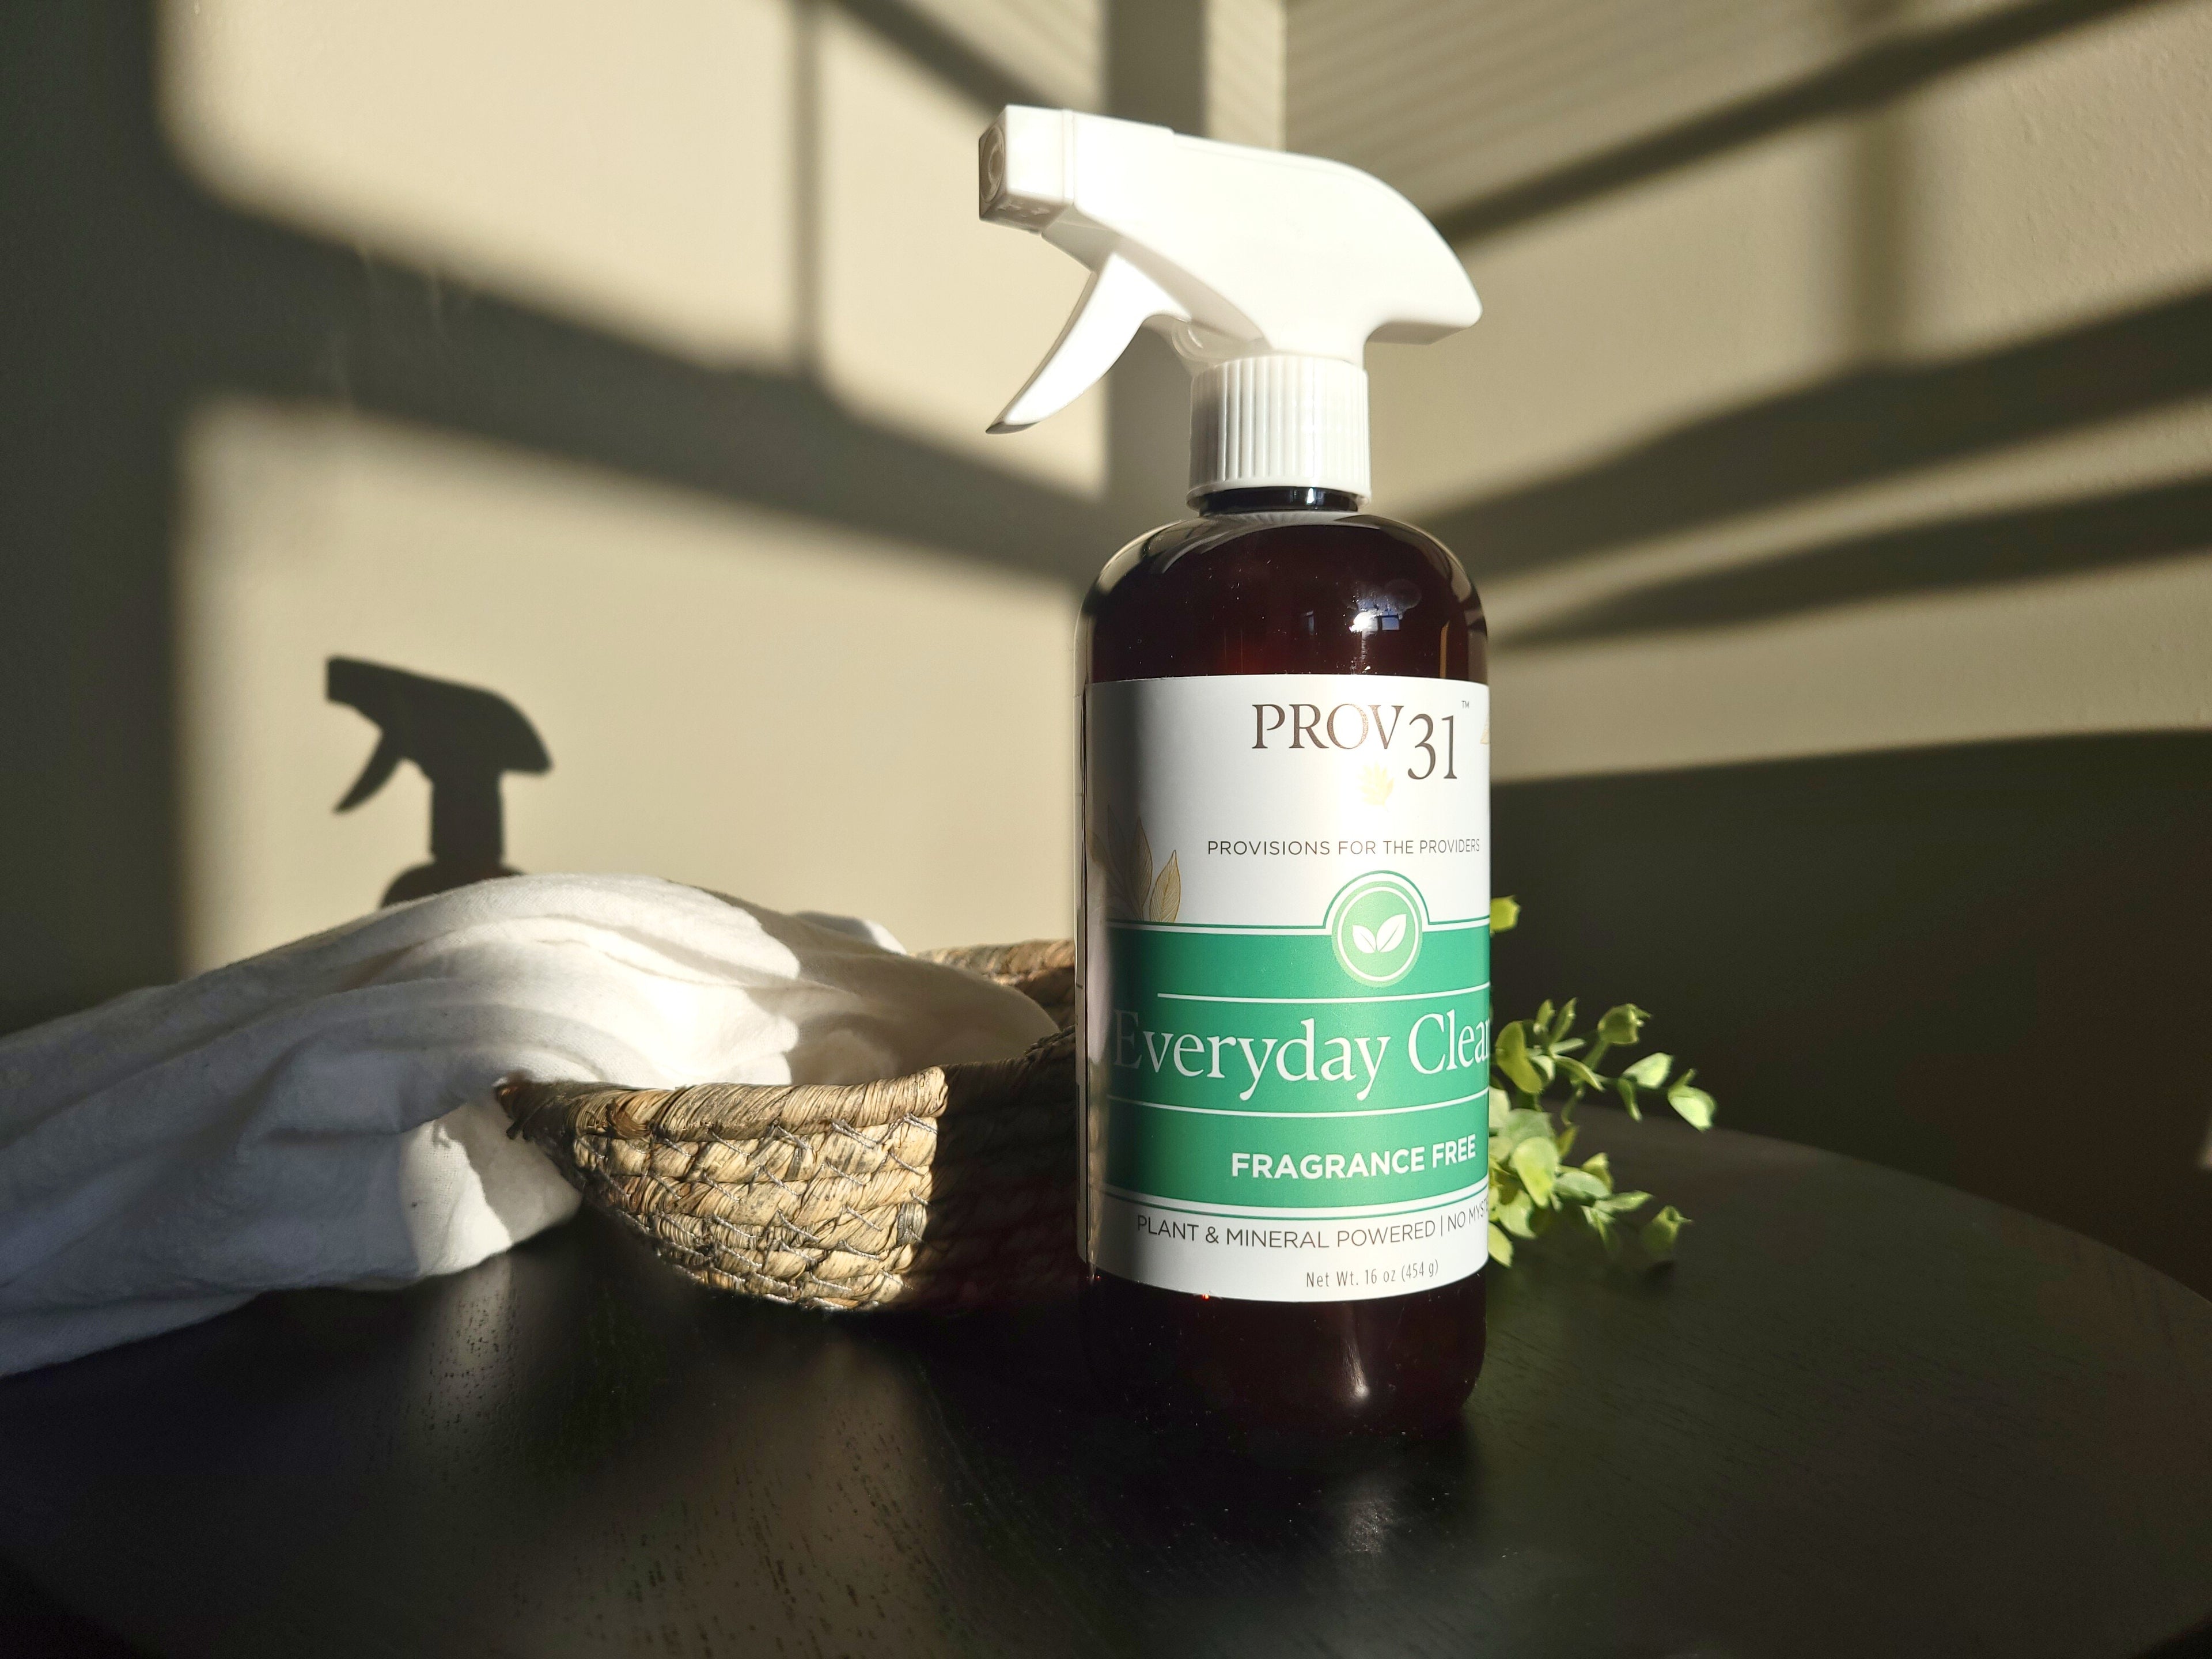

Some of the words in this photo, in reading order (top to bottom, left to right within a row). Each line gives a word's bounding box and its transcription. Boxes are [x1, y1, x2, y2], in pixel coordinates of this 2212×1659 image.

[1208, 840, 1330, 855] PROVISIONS
[1339, 840, 1376, 855] FOR
[1383, 840, 1414, 854] THE
[1420, 839, 1480, 854] PROVIDERS
[1113, 1009, 1391, 1101] Everyday
[1232, 1146, 1425, 1179] FRAGRANCE
[1432, 1134, 1476, 1168] FREE
[1137, 1214, 1199, 1241] PLANT
[1206, 1226, 1219, 1244] &
[1226, 1228, 1330, 1248] MINERAL
[1337, 1219, 1435, 1248] POWERED
[1448, 1210, 1466, 1232] NO
[1306, 1271, 1330, 1287] Net
[1337, 1270, 1359, 1286] Wt.
[1365, 1268, 1377, 1285] 16
[1383, 1270, 1396, 1282] oz
[1401, 1260, 1425, 1282] (454
[1428, 1258, 1438, 1278] g)
